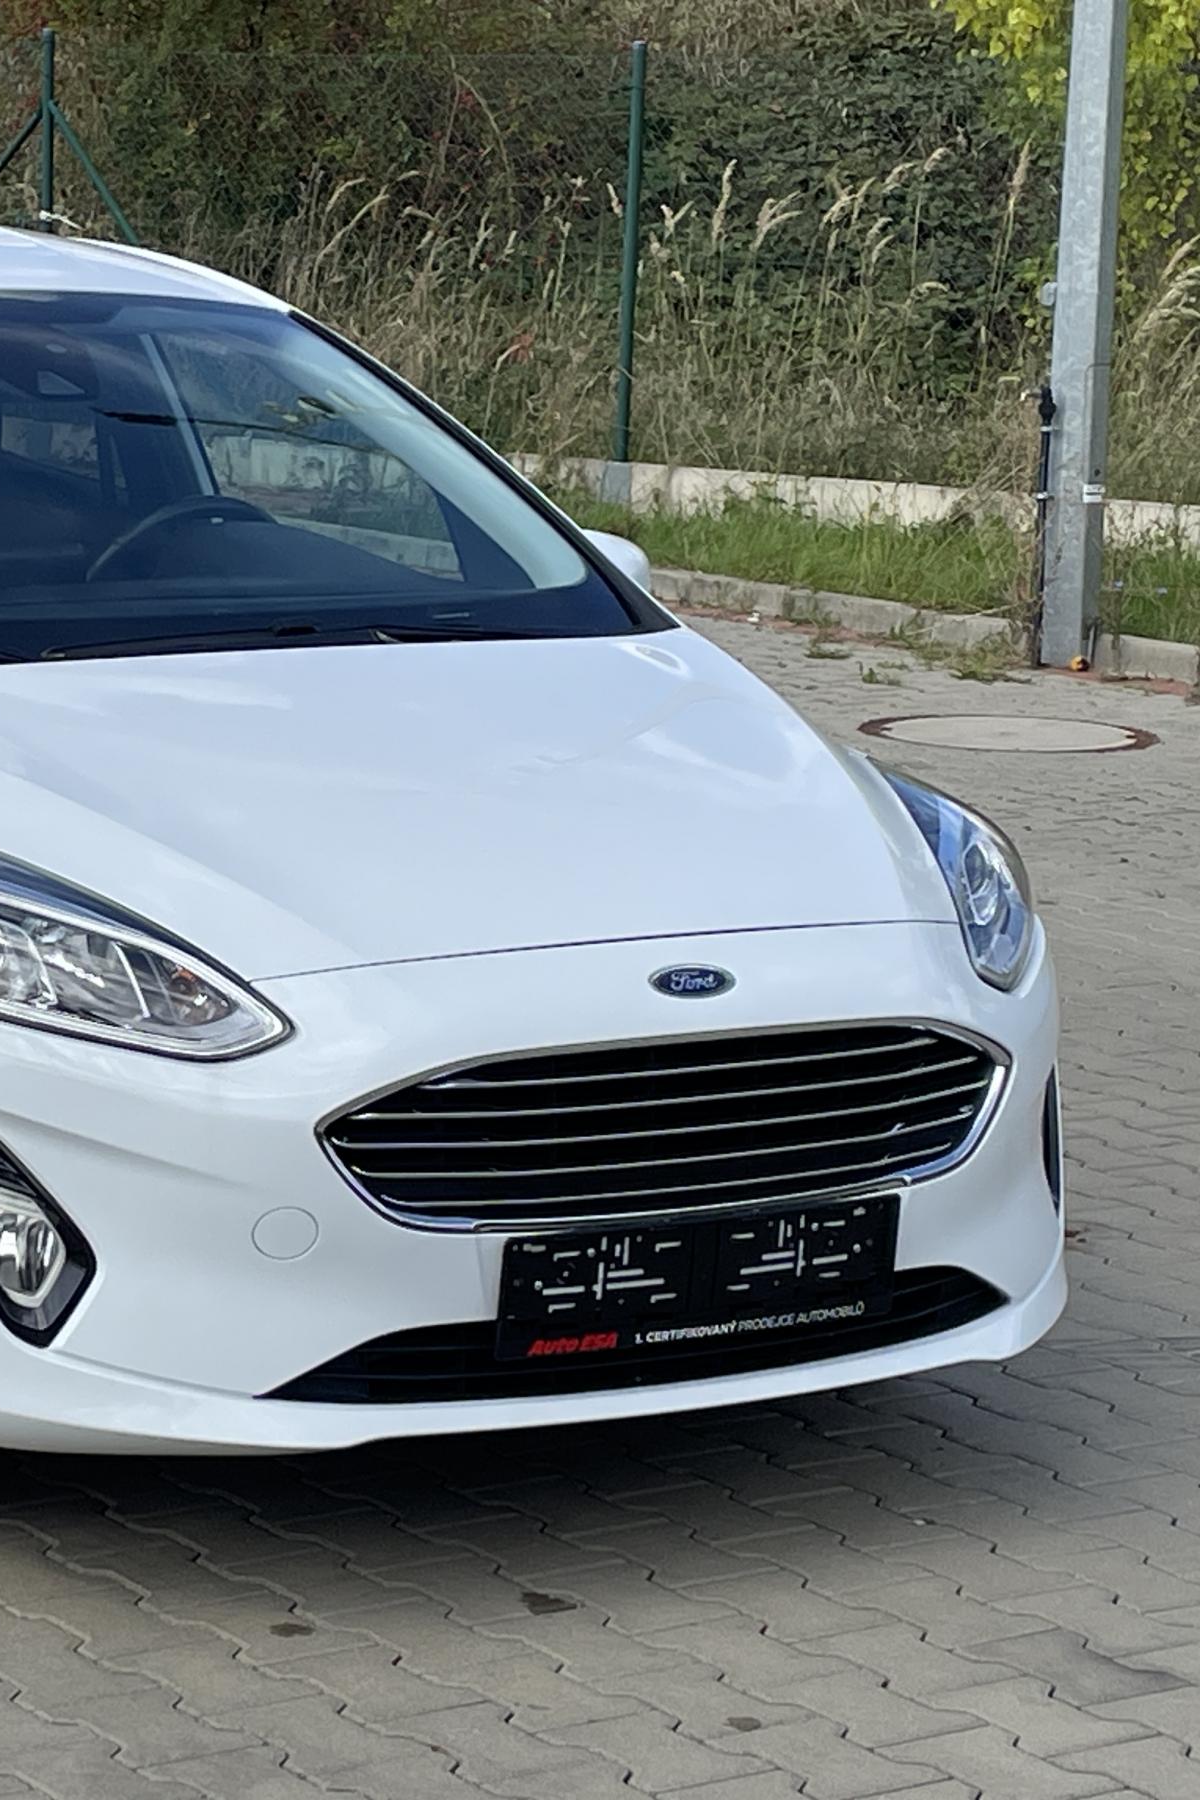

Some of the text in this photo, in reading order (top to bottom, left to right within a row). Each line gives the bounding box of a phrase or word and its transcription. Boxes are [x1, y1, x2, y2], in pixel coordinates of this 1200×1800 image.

[670, 971, 718, 992] Ford
[737, 1312, 796, 1332] PRODEJCE
[580, 1331, 618, 1351] ESA
